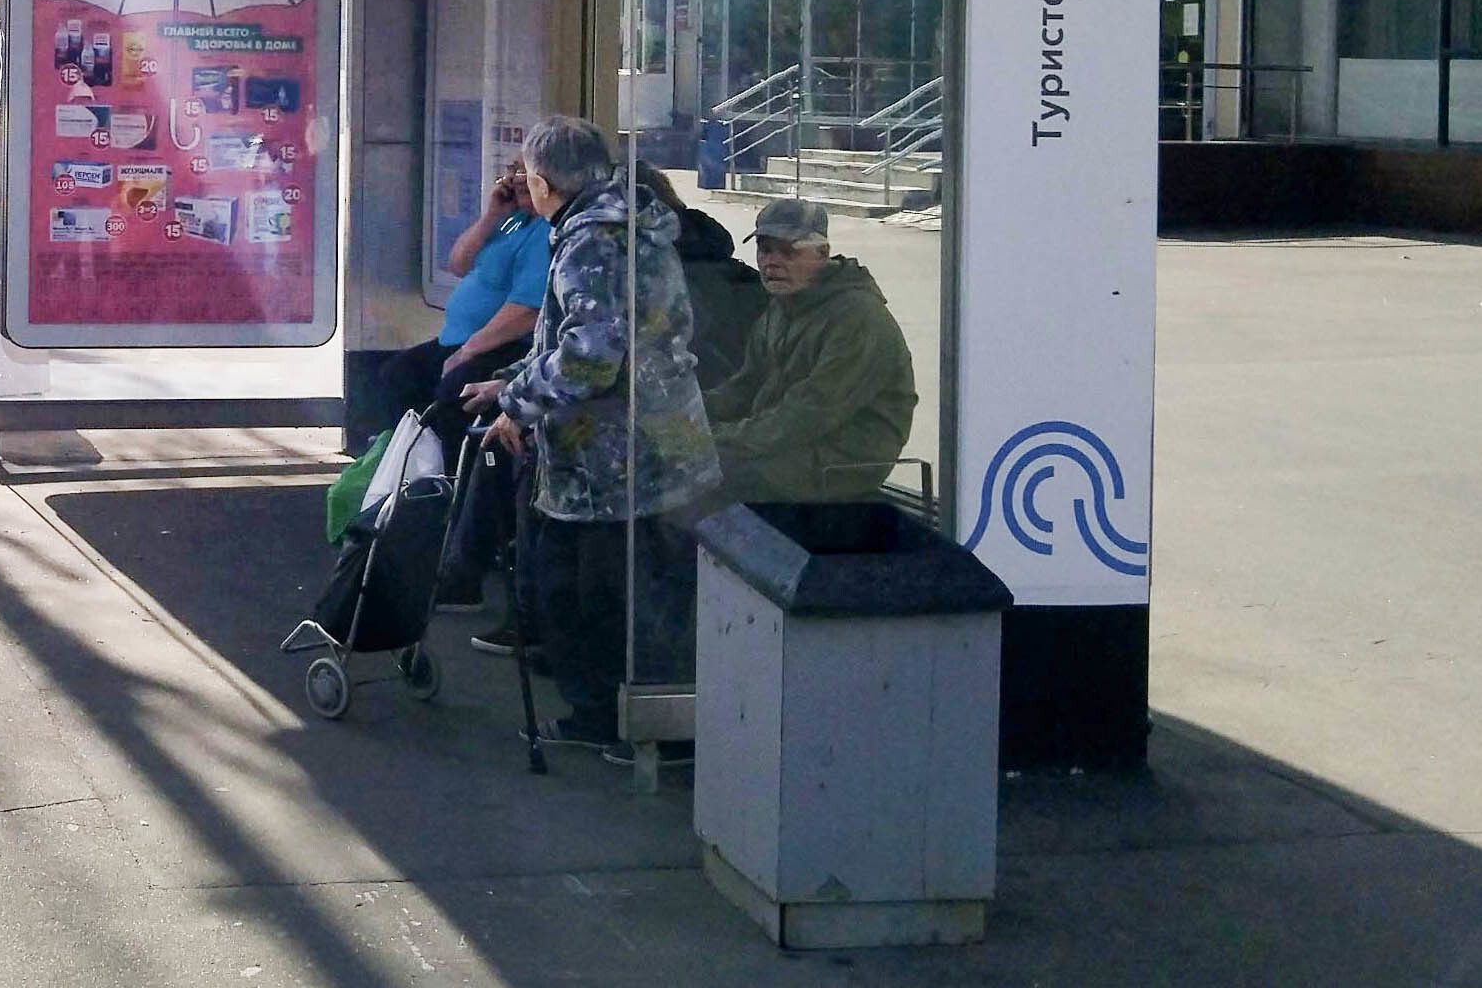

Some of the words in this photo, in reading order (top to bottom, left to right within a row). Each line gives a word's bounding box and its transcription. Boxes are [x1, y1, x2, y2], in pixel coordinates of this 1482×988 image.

[216, 27, 250, 37] ВСЕГО
[141, 60, 158, 72] 20
[61, 69, 78, 82] 15
[184, 101, 200, 114] 15
[263, 109, 279, 121] 15
[92, 132, 109, 145] 15
[279, 146, 295, 159] 15
[190, 158, 207, 171] 15
[284, 188, 301, 200] 20
[165, 224, 181, 237] 15
